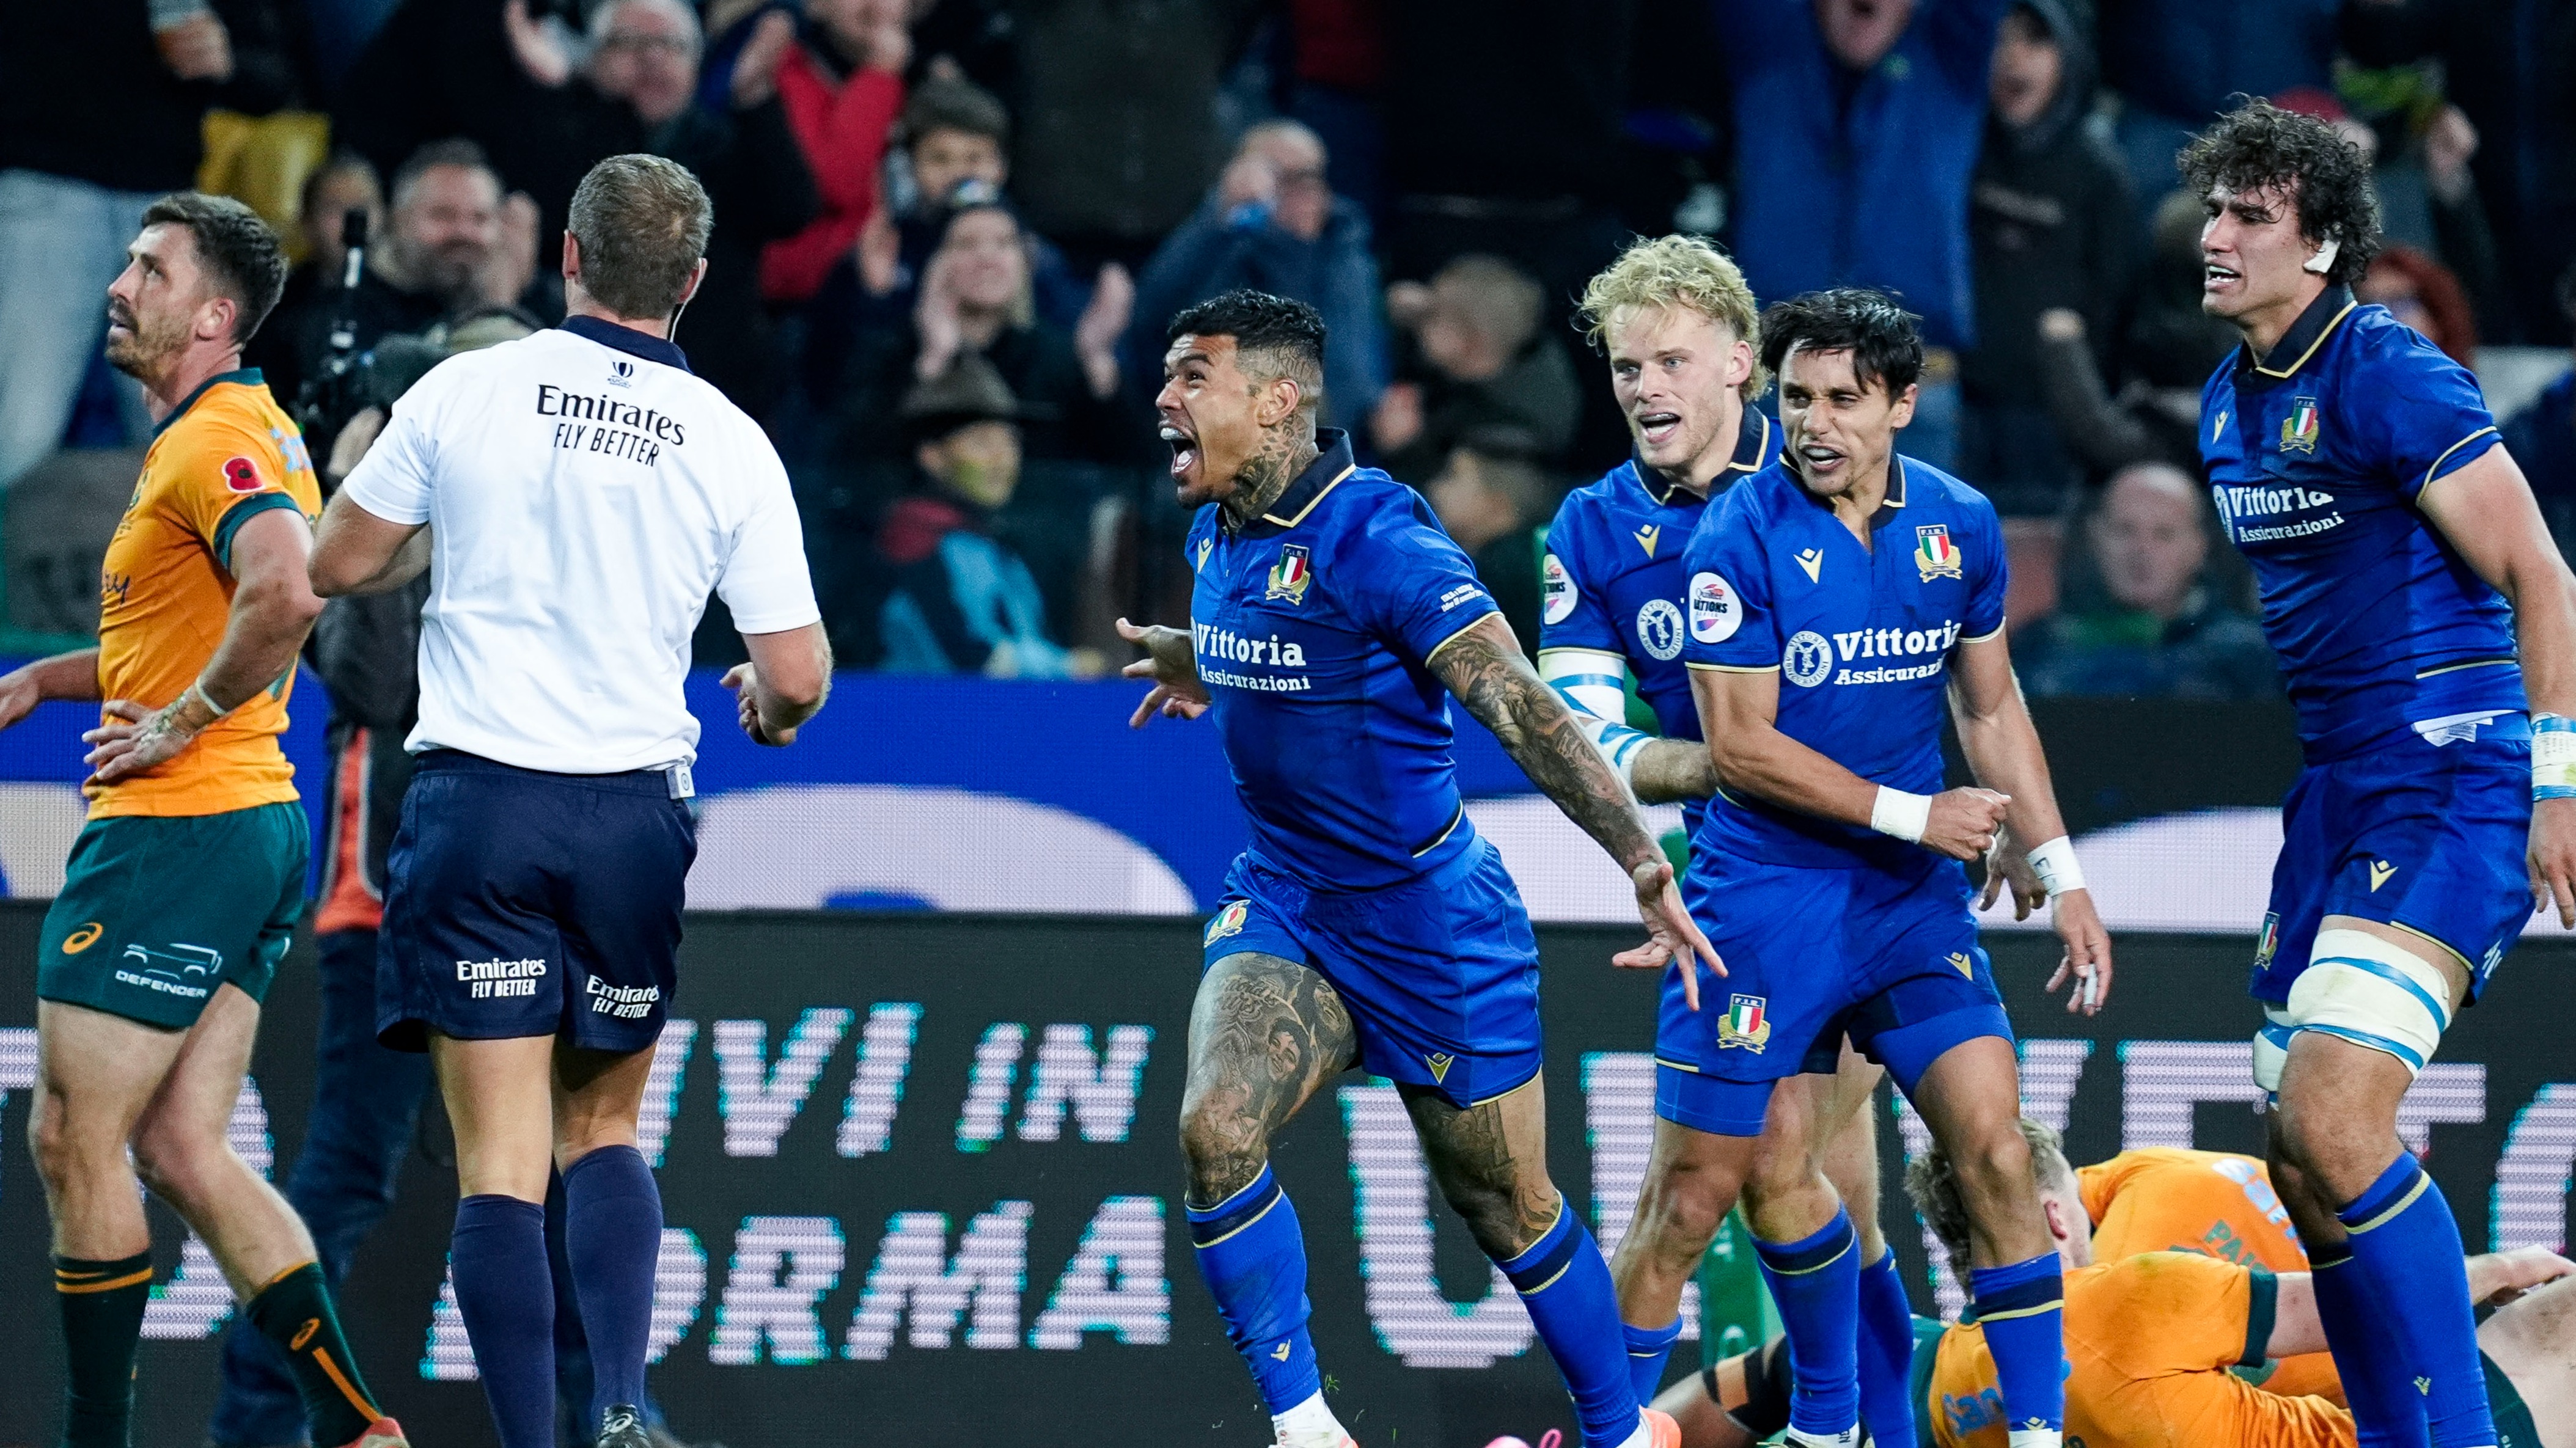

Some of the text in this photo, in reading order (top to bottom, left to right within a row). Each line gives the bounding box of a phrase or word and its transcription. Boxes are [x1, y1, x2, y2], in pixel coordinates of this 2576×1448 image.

[537, 384, 685, 445] Emirates
[554, 423, 659, 467] FLY BETTER
[2228, 487, 2335, 517] Vittoria
[2237, 511, 2345, 543] Assicurazioni
[1640, 601, 1676, 622] VITTORIA
[1197, 623, 1307, 667] Vittoria
[1788, 634, 1828, 651] VITTORIA
[1200, 664, 1312, 692] Assicurazioni
[456, 957, 547, 981] Emirates
[115, 970, 208, 998] DEFENDER
[471, 978, 536, 998] FLY BETTER
[592, 996, 652, 1018] FLY BETTER
[955, 1022, 1157, 1154] IN
[419, 1193, 1172, 1382] RMA
